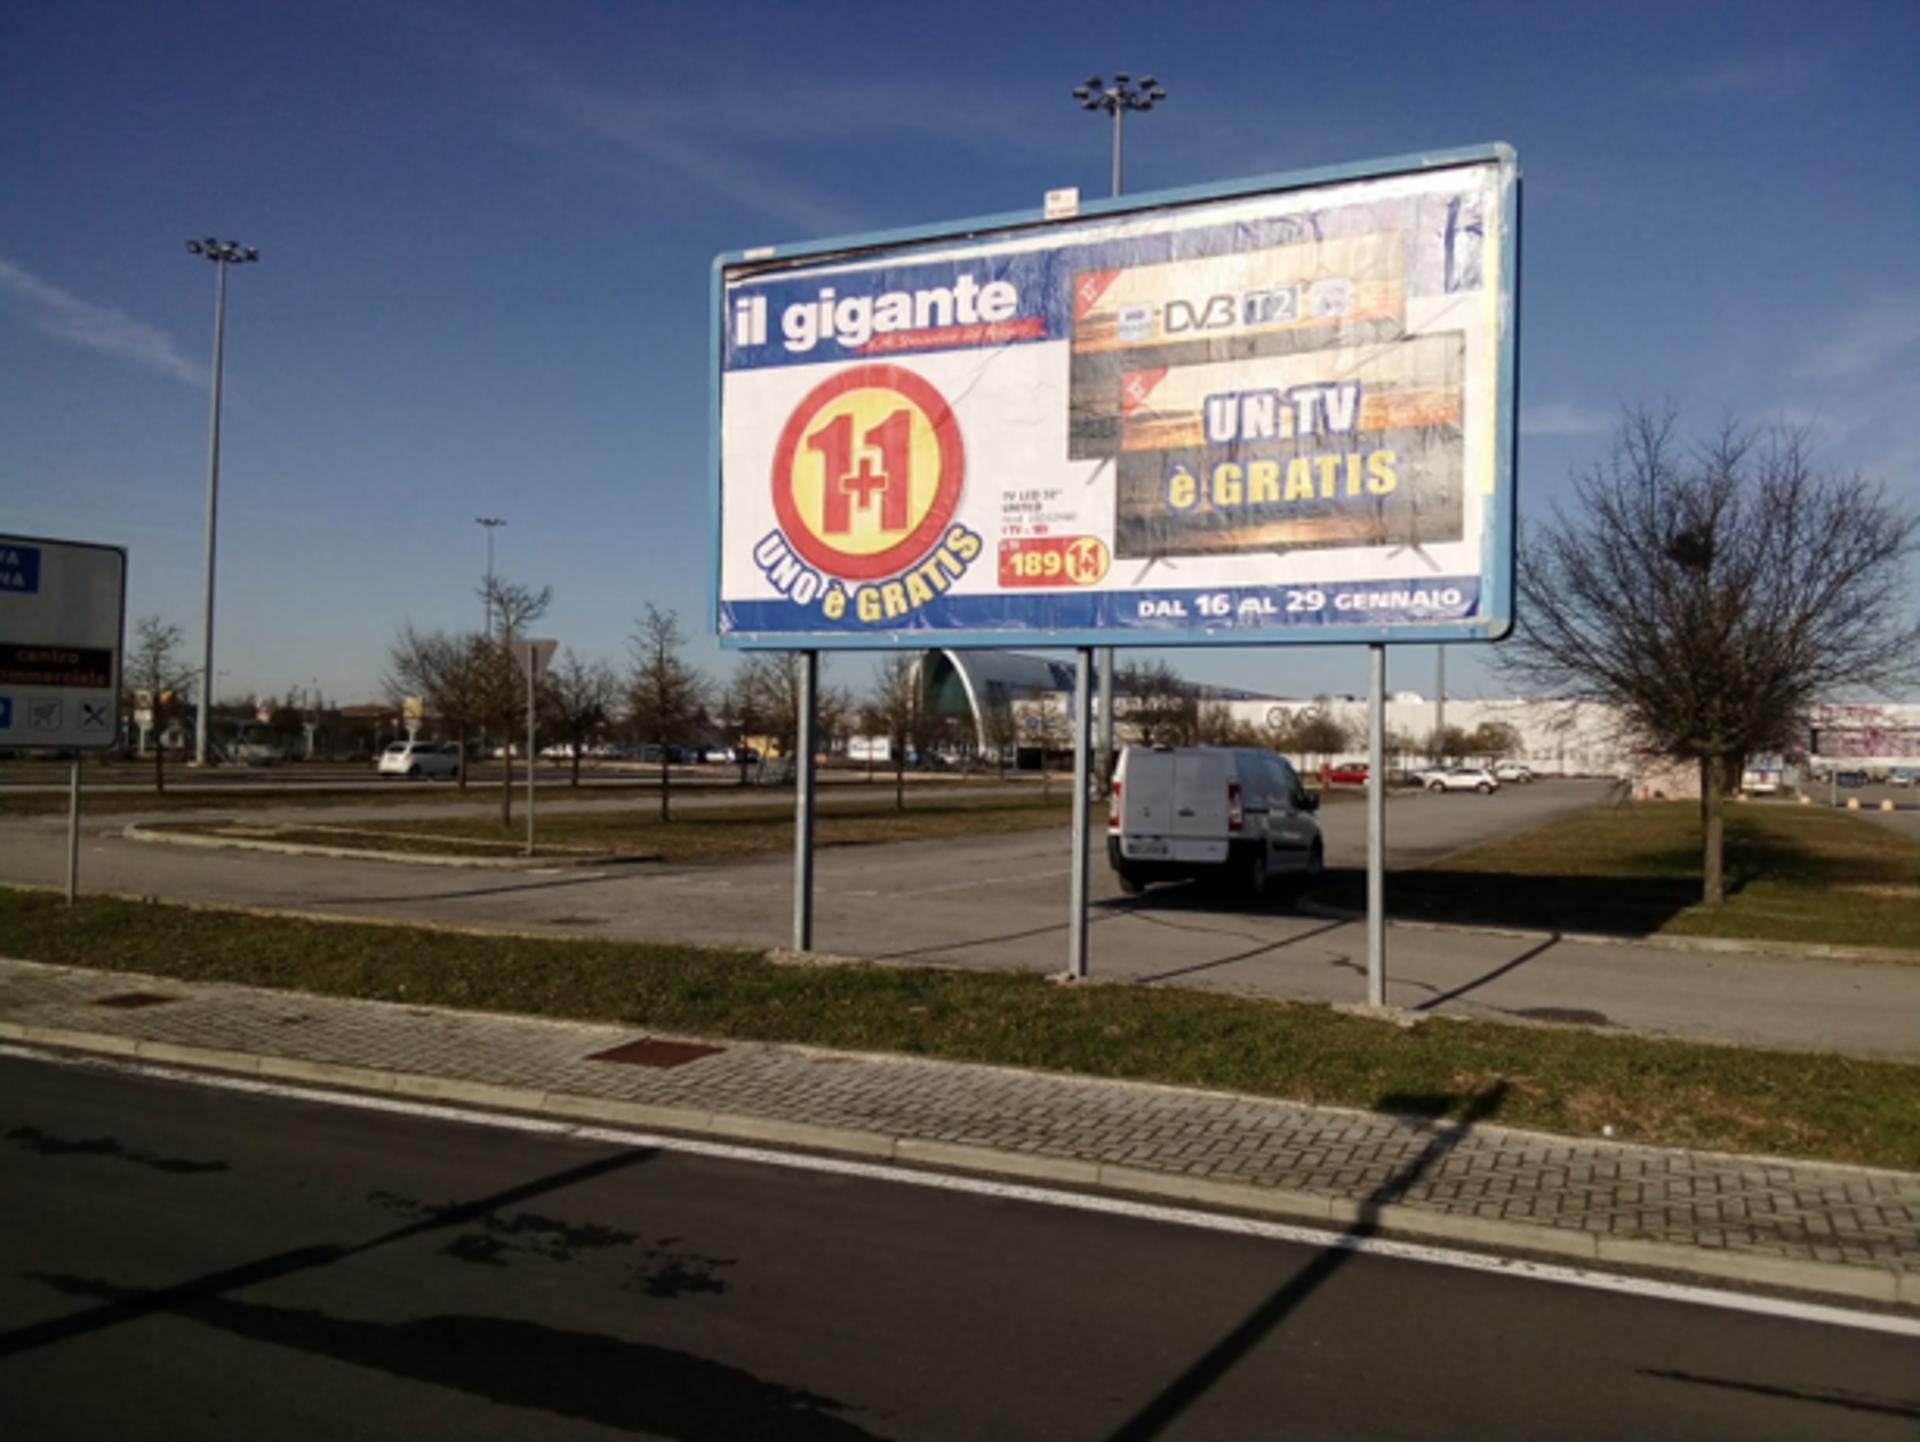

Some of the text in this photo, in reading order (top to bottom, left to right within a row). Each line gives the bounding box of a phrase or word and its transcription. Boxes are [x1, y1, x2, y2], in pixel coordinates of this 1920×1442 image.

[736, 296, 767, 346] il
[782, 274, 1018, 351] gigante
[1164, 296, 1236, 333] DVB
[1211, 450, 1398, 507] GRATIS
[754, 530, 819, 605] UNO
[857, 525, 982, 622] GRATIS
[1010, 549, 1061, 577] 189
[1138, 588, 1462, 617] DAL 16 AL 29 GENNAIO
